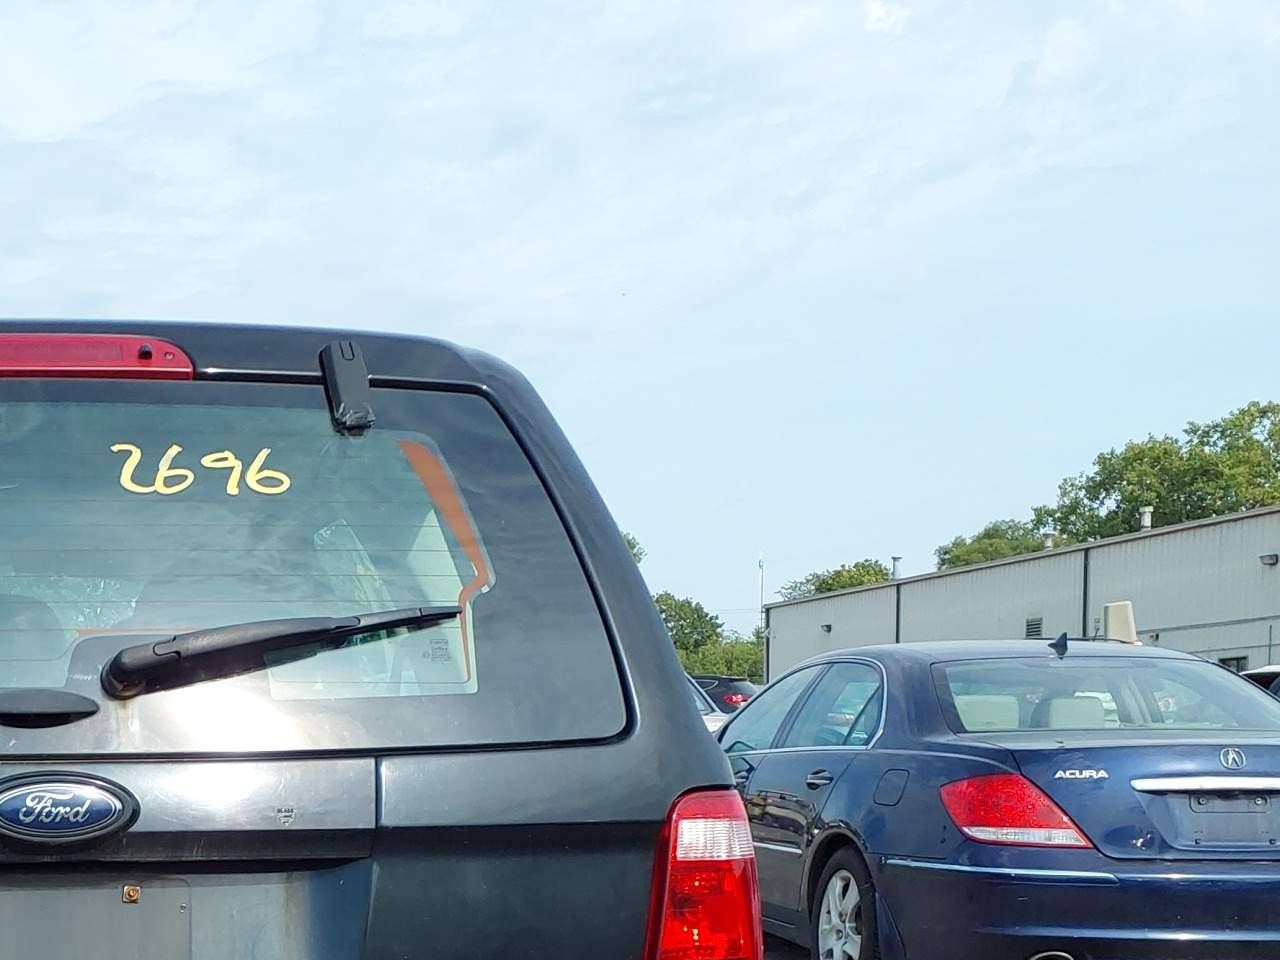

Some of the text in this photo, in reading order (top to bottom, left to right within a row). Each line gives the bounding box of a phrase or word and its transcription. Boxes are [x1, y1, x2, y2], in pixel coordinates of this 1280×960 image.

[110, 443, 291, 495] 2696
[1054, 769, 1109, 779] ACURA
[19, 792, 91, 824] Ford
